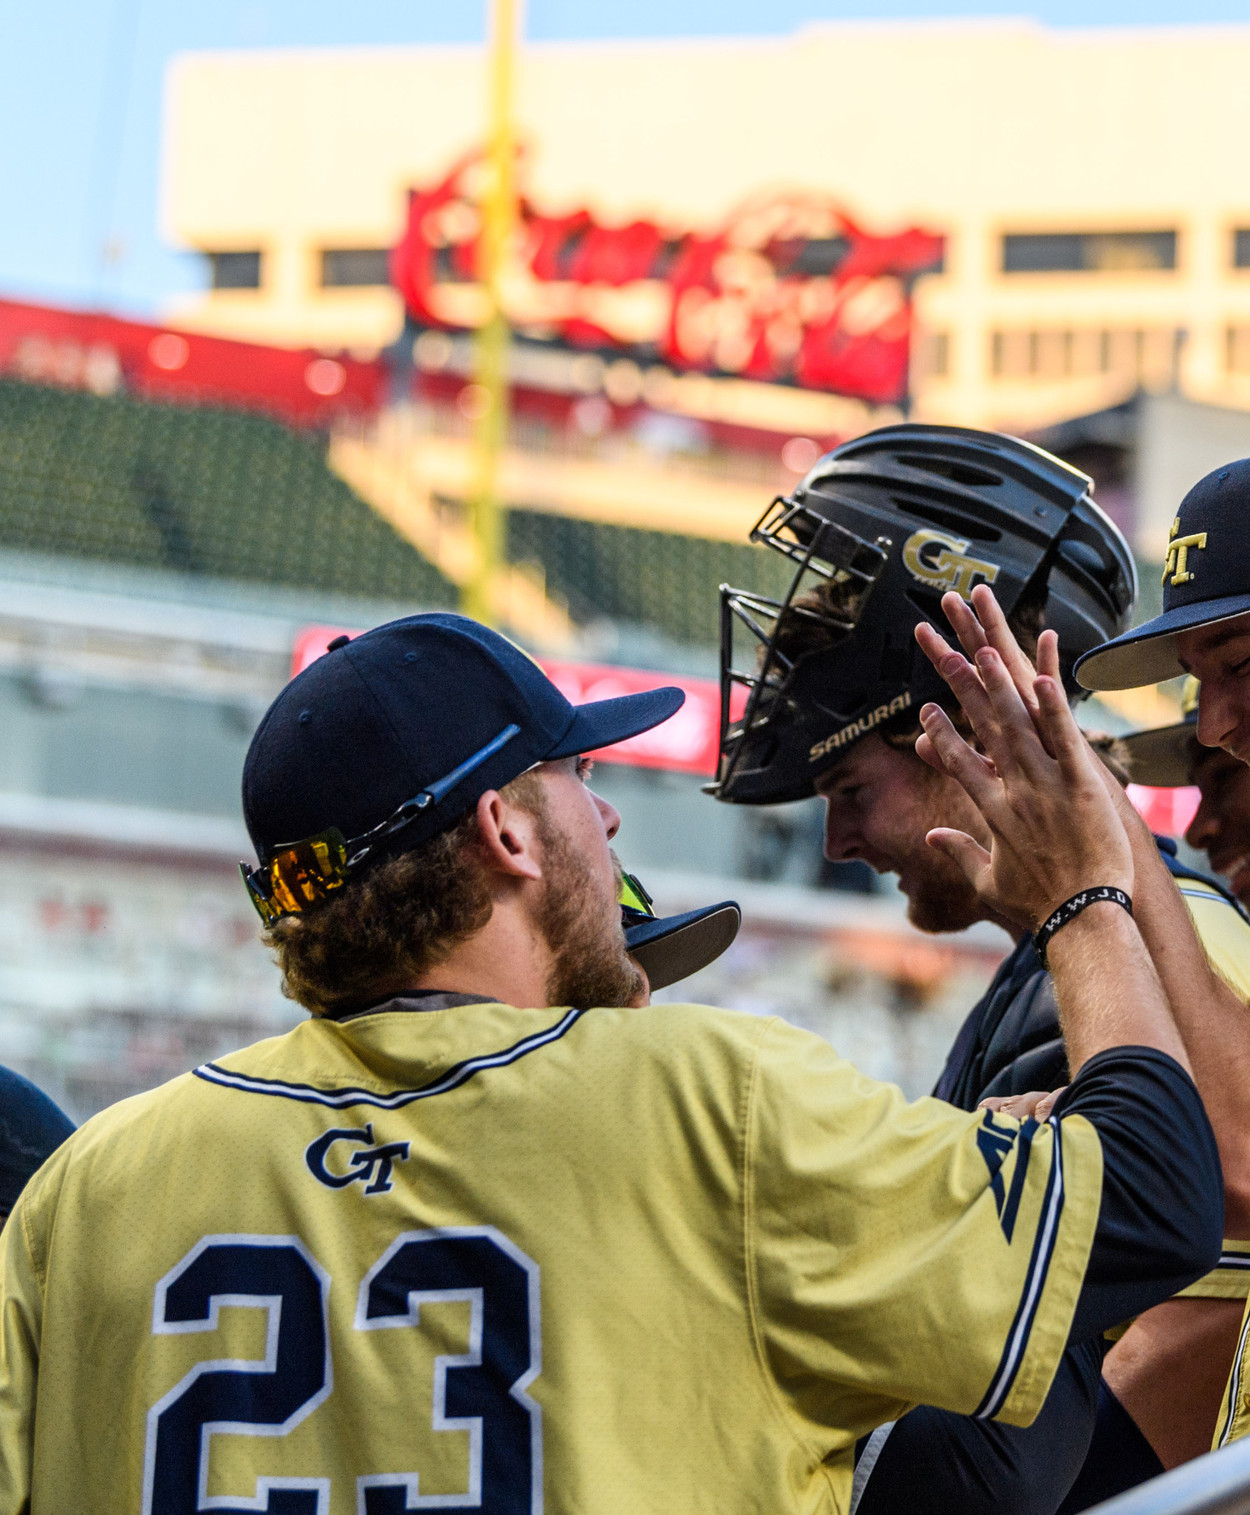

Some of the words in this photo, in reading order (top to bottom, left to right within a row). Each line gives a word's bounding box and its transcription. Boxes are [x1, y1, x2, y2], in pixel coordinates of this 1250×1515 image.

[902, 528, 1001, 602] GT
[808, 690, 912, 763] SAMURAI
[304, 1121, 412, 1196] GT
[141, 1224, 544, 1515] 23
